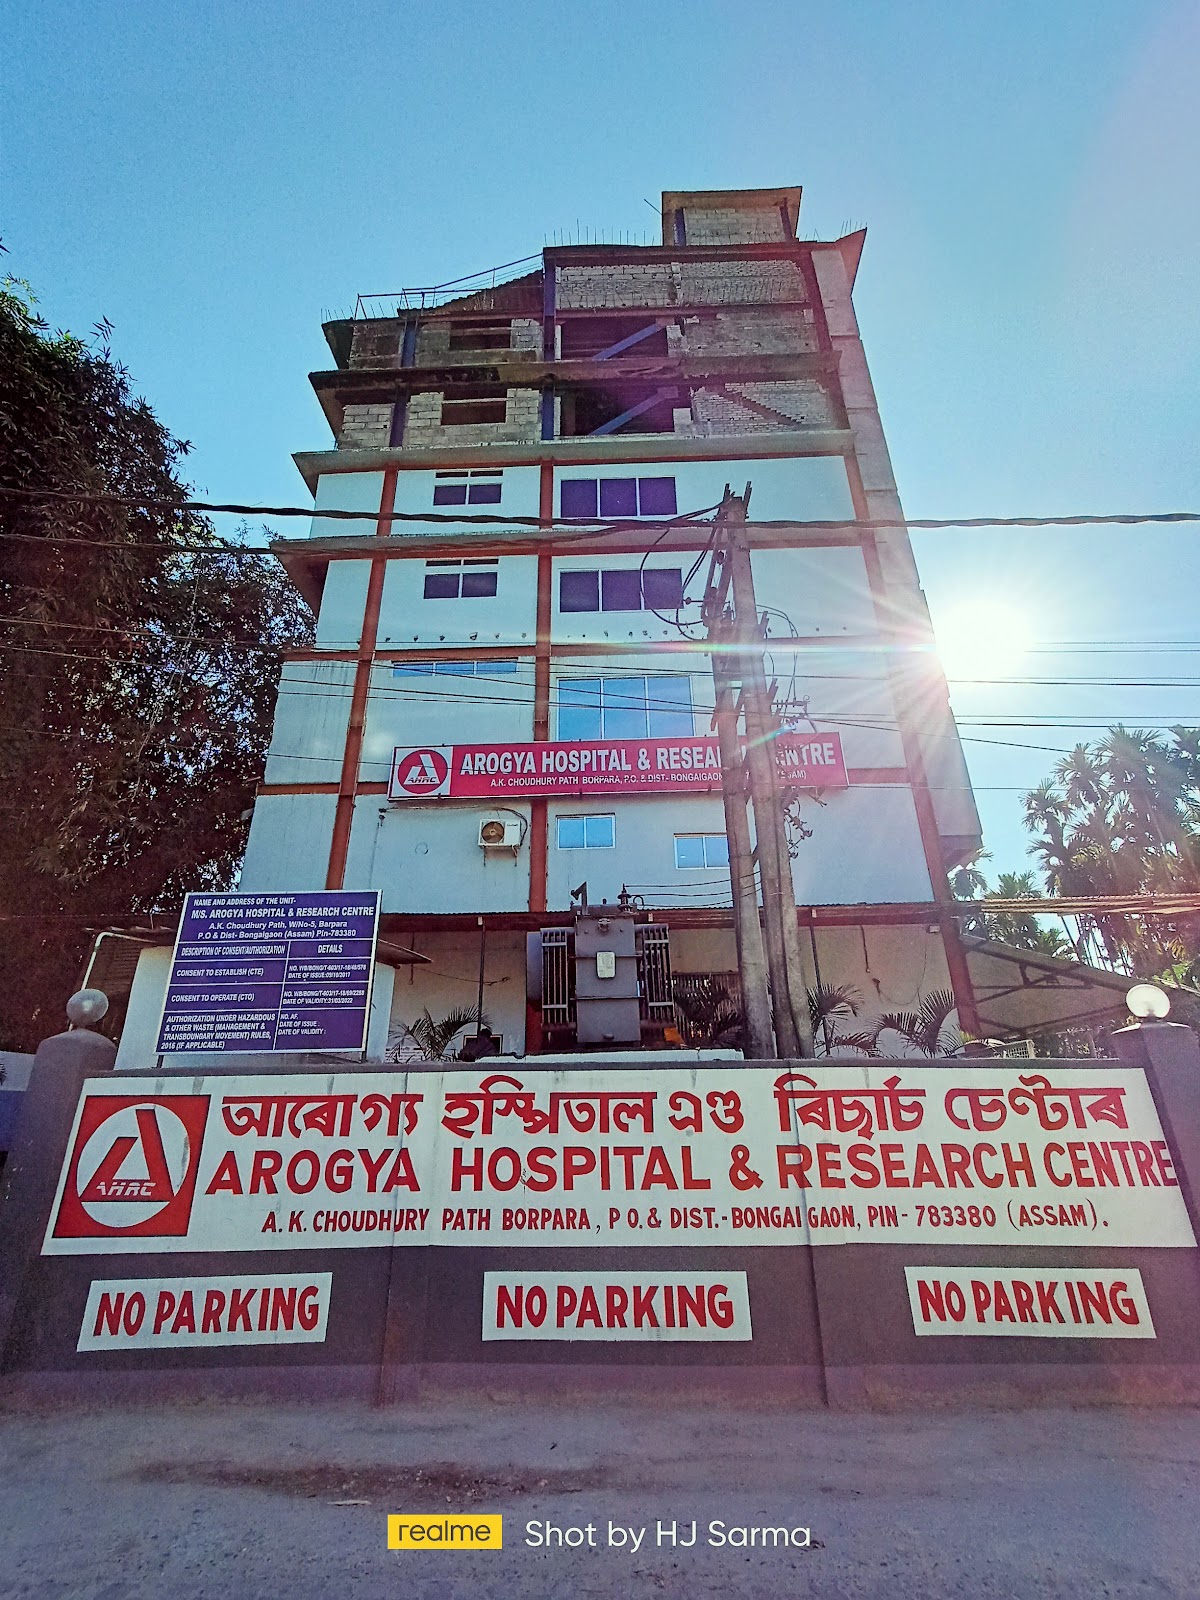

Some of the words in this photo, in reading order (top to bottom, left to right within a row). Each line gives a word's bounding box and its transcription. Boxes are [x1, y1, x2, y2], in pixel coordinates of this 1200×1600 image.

[460, 750, 536, 775] AROGYA
[541, 748, 631, 773] HOSPITAL
[637, 747, 651, 771] &
[490, 778, 506, 787] A.K.
[508, 777, 557, 786] CHOUDHURY
[558, 776, 579, 785] PATH
[226, 898, 255, 906] ADDRESS
[266, 897, 279, 905] THE
[209, 909, 244, 919] AROGYA
[245, 908, 285, 918] HOSPITAL
[287, 908, 294, 917] &
[296, 907, 340, 917] RESEARCH
[341, 906, 374, 916] CENTRE
[208, 922, 224, 930] A.K.
[226, 922, 267, 931] Choudhury
[268, 921, 287, 930] Path,
[318, 920, 348, 929] Barpara
[239, 931, 283, 940] Bongaigaon
[284, 930, 315, 939] (Assam)
[316, 929, 357, 938] Pin-783380
[180, 947, 214, 956] DESCRIPTION
[214, 947, 222, 956] OF
[317, 944, 343, 953] DETAILS
[176, 969, 205, 977] CONSENT
[214, 968, 247, 976] ESTABLISH
[247, 968, 264, 976] (CTE)
[171, 994, 201, 1002] CONSENT
[210, 993, 238, 1001] OPERATE
[238, 993, 255, 1002] (CTO)
[166, 1014, 216, 1023] AUTHORIZATION
[216, 1014, 238, 1022] UNDER
[238, 1013, 276, 1021] HAZARDOUS
[192, 1023, 214, 1031] WASTE
[214, 1022, 259, 1032] (MANAGEMENT
[161, 1042, 176, 1050] 2016
[185, 1041, 225, 1050] APPLICABLE)
[205, 1147, 421, 1196] AROGYA
[450, 1144, 712, 1193] HOSPITAL
[728, 1143, 764, 1192] &
[776, 1142, 1037, 1189] RESEARCH
[1043, 1141, 1179, 1188] CENTRE
[96, 1181, 157, 1196] AHRC
[312, 1208, 430, 1232] CHOUDHURY
[441, 1208, 491, 1231] PATH
[915, 1205, 997, 1228] 783380
[496, 1285, 548, 1329] NO
[556, 1283, 735, 1329] PARKING
[916, 1280, 967, 1323] NO
[970, 1280, 1141, 1326] PARKING
[93, 1291, 146, 1337] NO
[152, 1285, 320, 1335] PARKING
